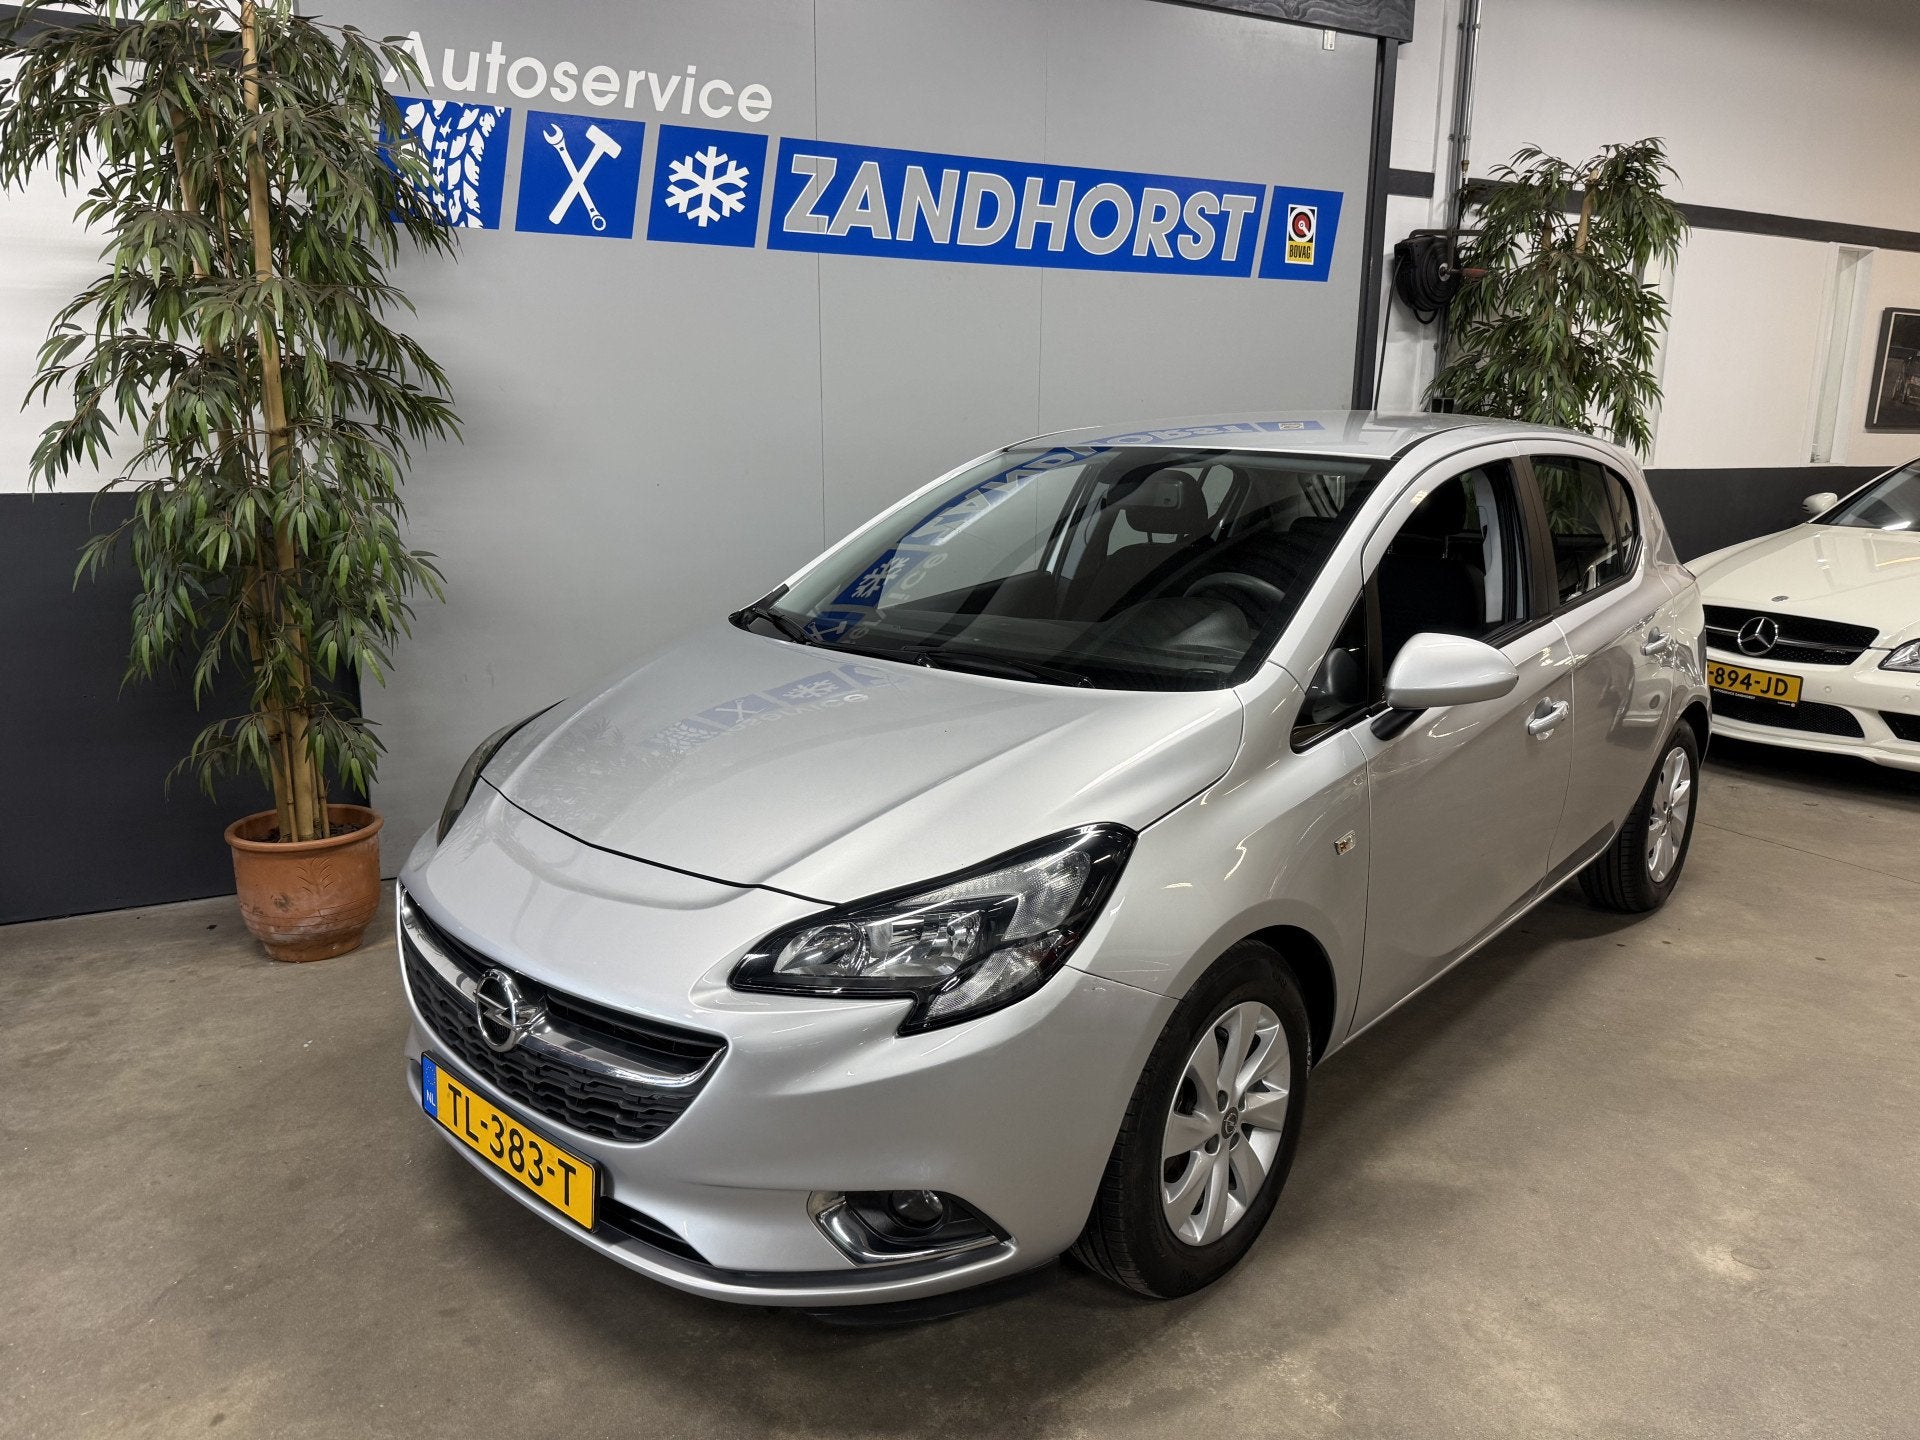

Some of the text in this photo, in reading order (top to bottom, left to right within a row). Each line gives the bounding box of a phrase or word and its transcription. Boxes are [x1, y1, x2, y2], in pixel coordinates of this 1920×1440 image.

[384, 31, 773, 123] Autoservice
[783, 154, 1256, 262] ZANDHORST
[1289, 244, 1311, 259] BOVAG
[1707, 665, 1789, 697] -894-JD
[426, 1090, 436, 1107] NL
[447, 1082, 577, 1207] TL-383-T
